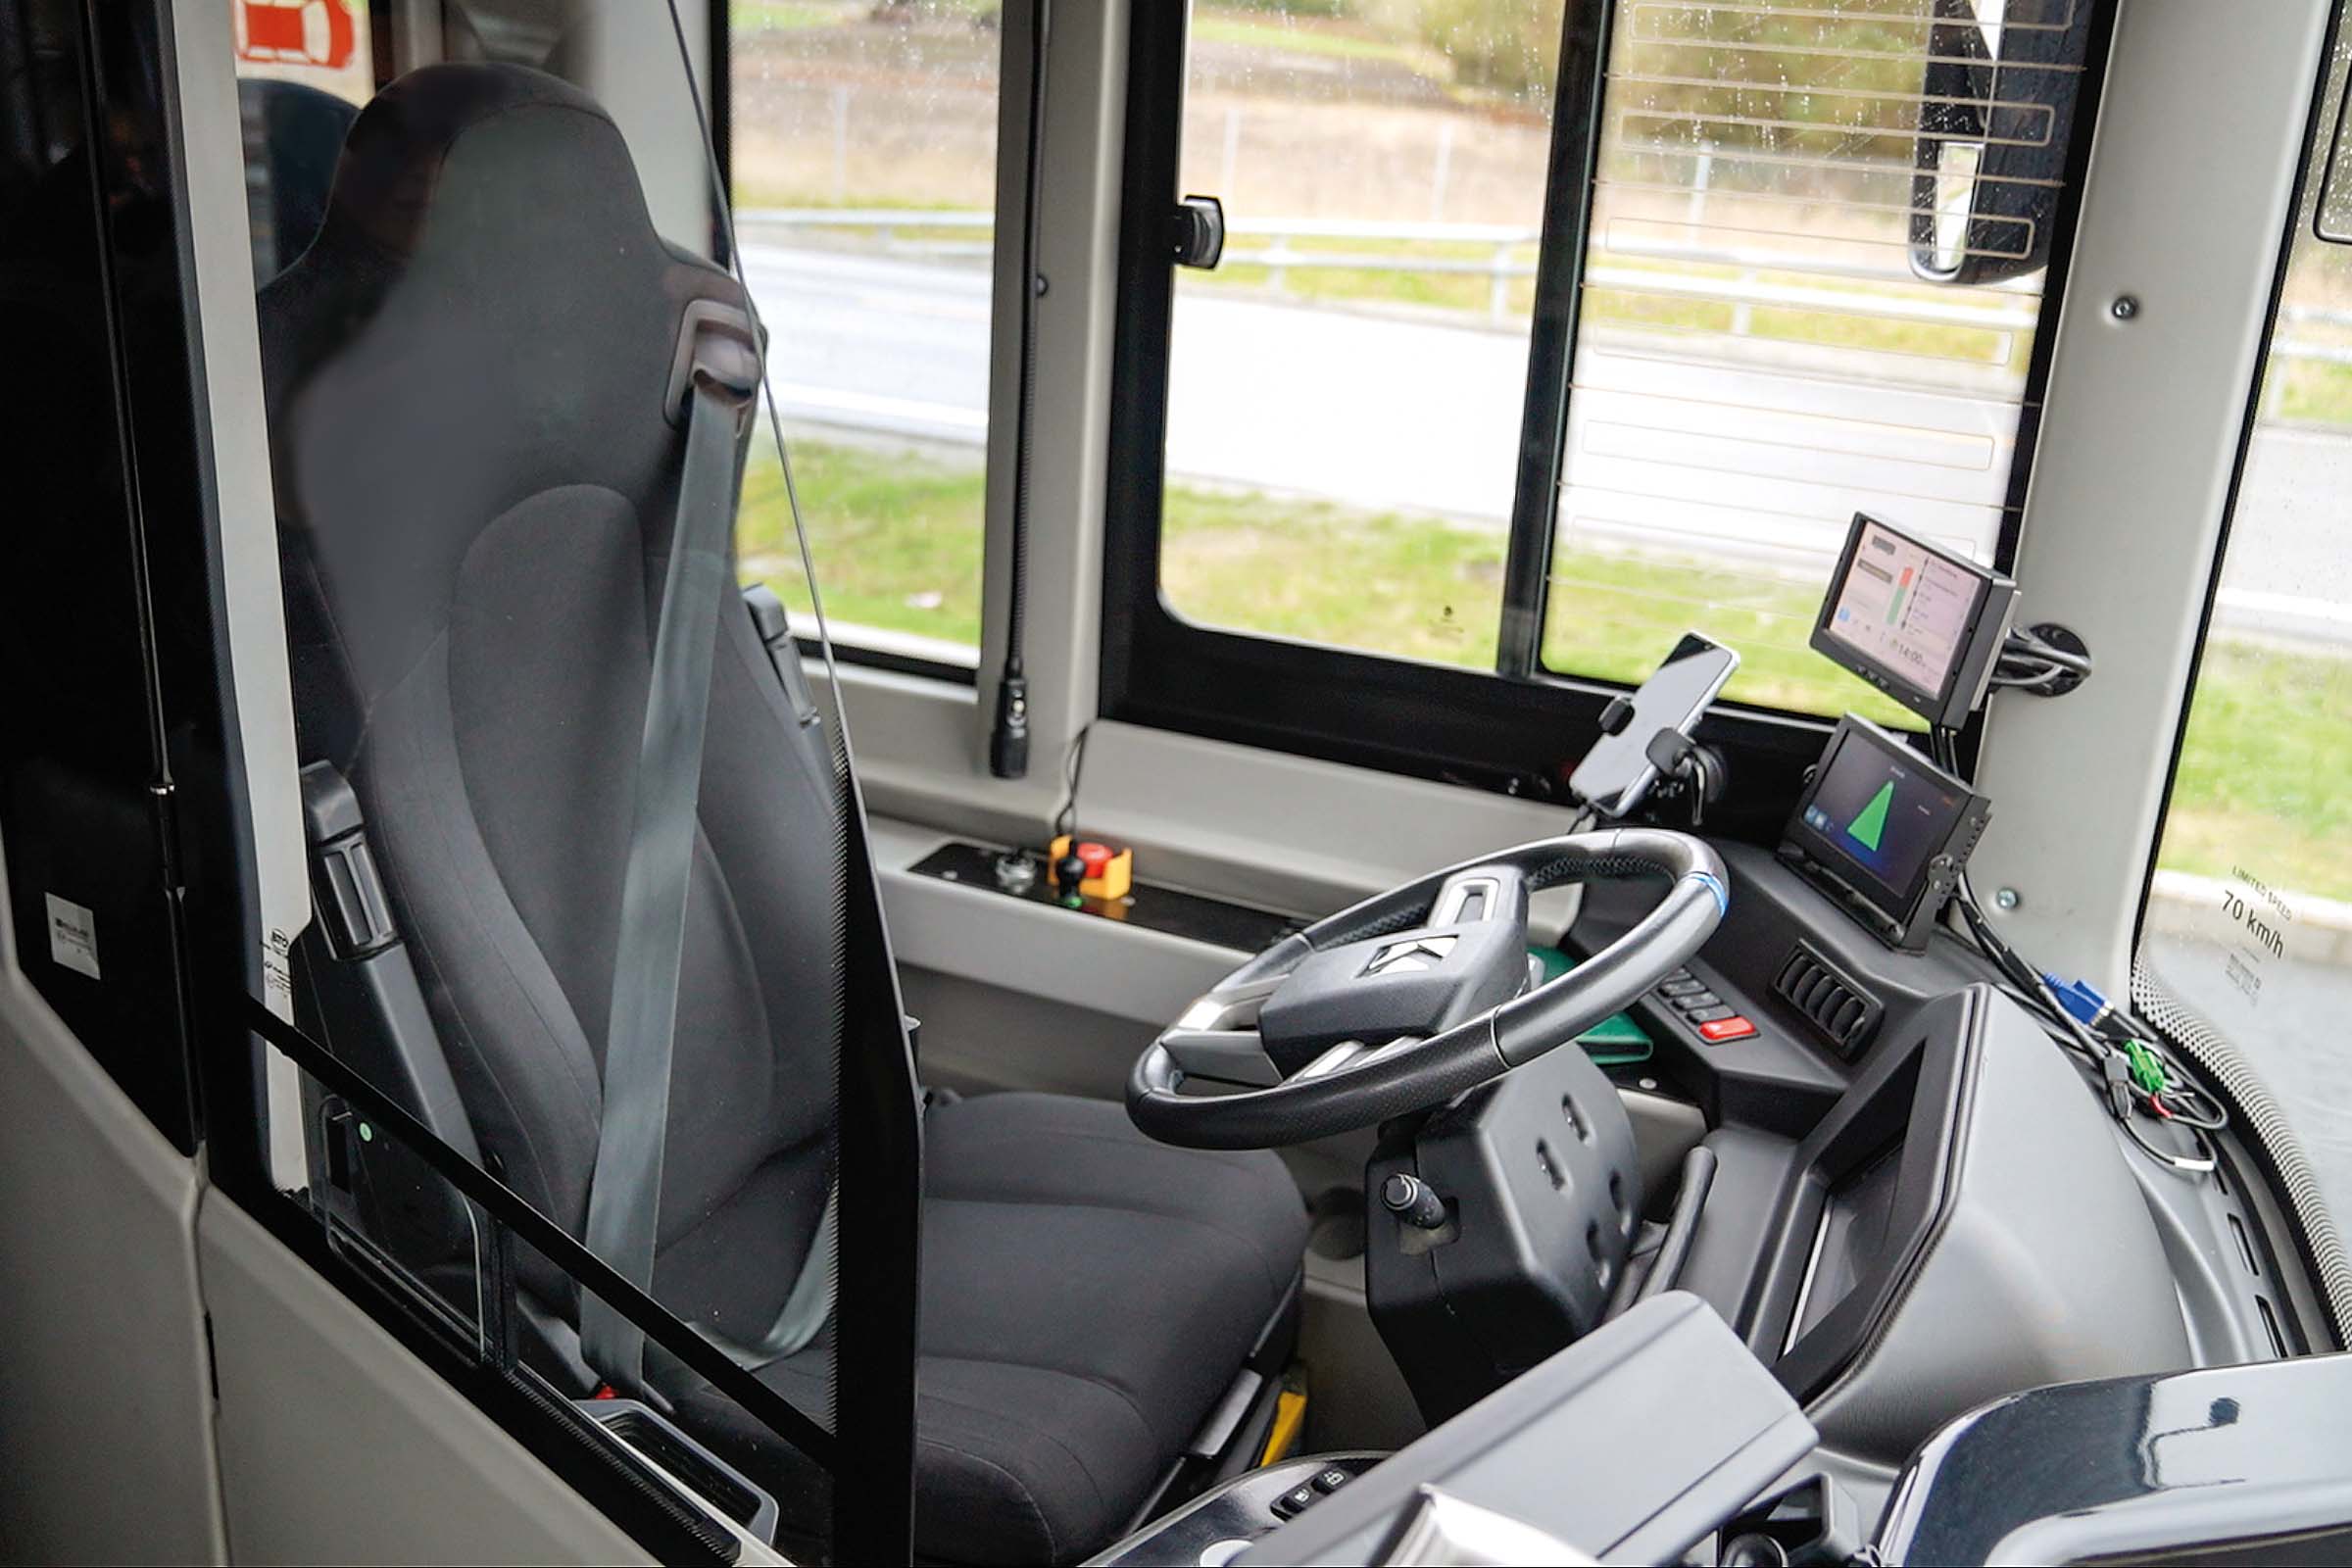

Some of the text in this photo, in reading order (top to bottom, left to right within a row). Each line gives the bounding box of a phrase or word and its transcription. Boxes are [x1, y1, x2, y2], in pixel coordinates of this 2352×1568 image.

[2231, 865, 2267, 897] LIMITED
[2222, 890, 2244, 920] 70
[2246, 909, 2283, 958] km/h
